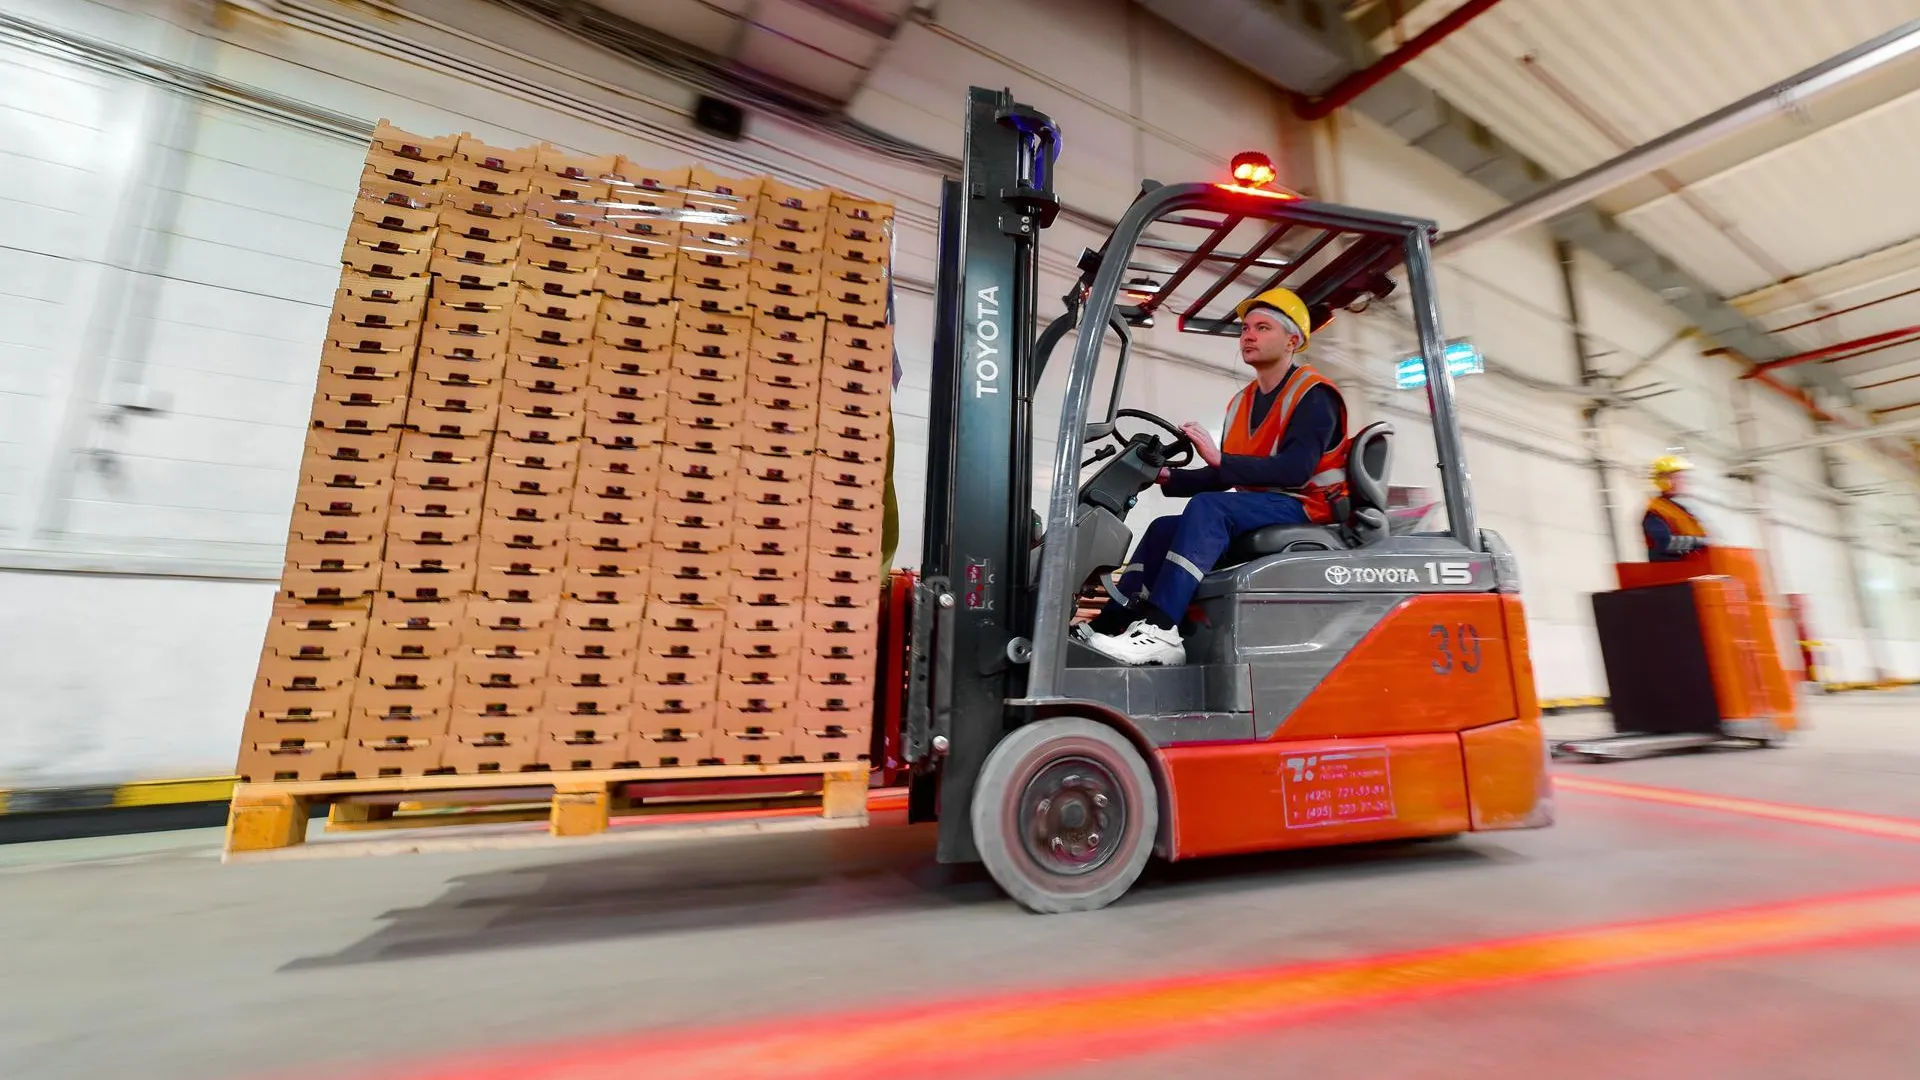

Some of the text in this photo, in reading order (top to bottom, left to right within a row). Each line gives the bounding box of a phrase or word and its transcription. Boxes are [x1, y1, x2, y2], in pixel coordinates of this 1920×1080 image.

[976, 285, 999, 399] TOYOTA
[1352, 567, 1420, 583] TOYOTA
[1428, 623, 1482, 675] 39
